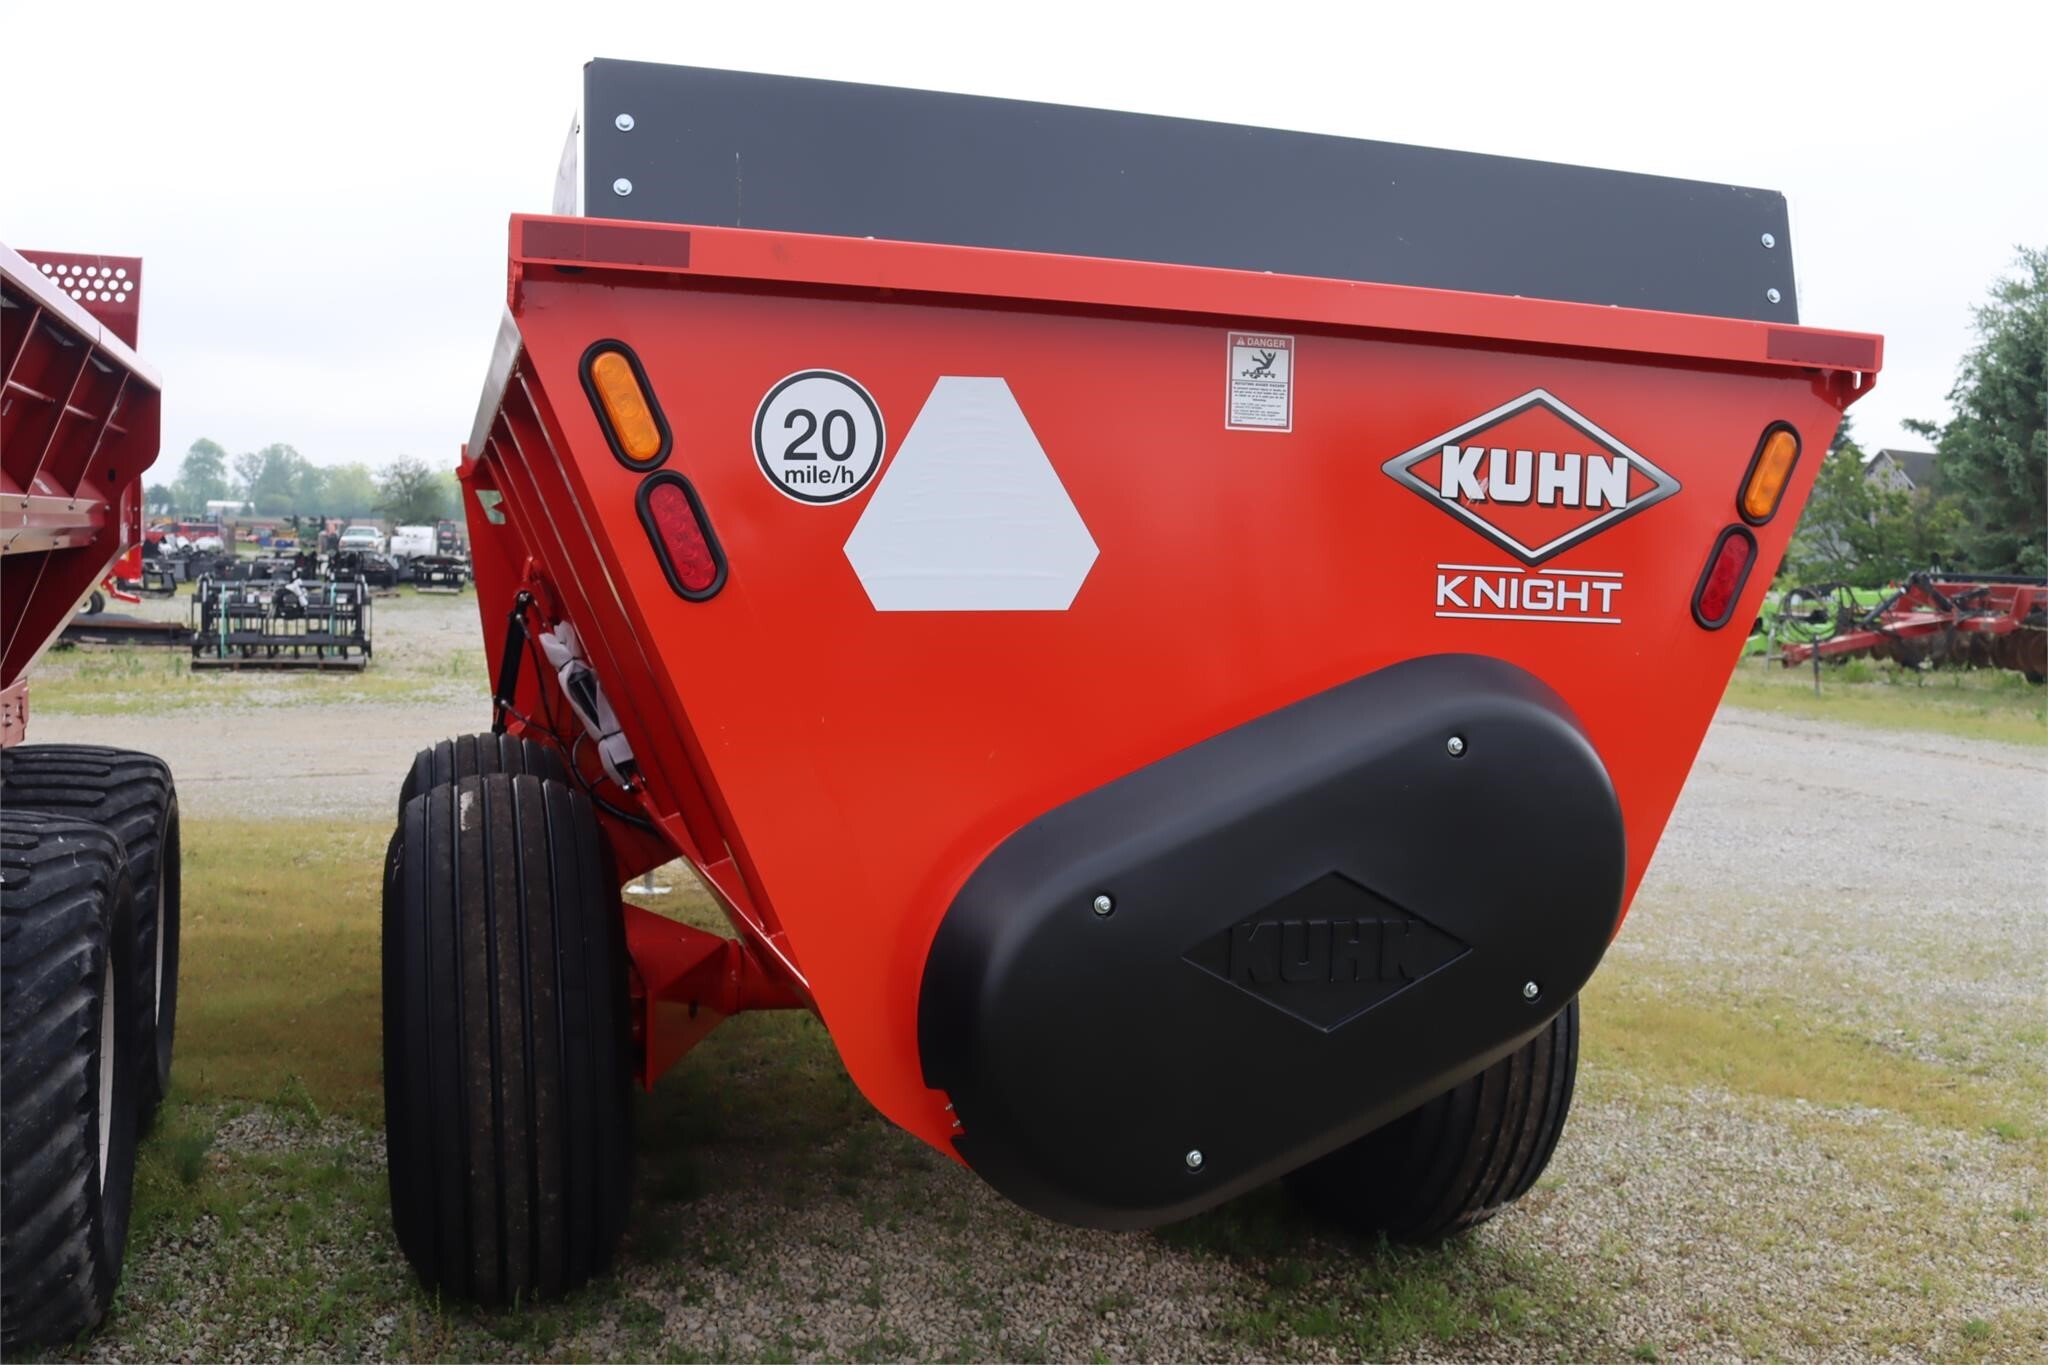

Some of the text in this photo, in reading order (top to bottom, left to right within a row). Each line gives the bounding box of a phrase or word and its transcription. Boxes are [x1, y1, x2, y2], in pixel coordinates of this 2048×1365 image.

[1247, 337, 1286, 348] DANGER
[783, 408, 856, 461] 20
[784, 465, 854, 484] mile/h
[1440, 445, 1629, 509] KUHN
[1436, 574, 1622, 613] KNIGHT
[1229, 918, 1418, 983] KUHN
